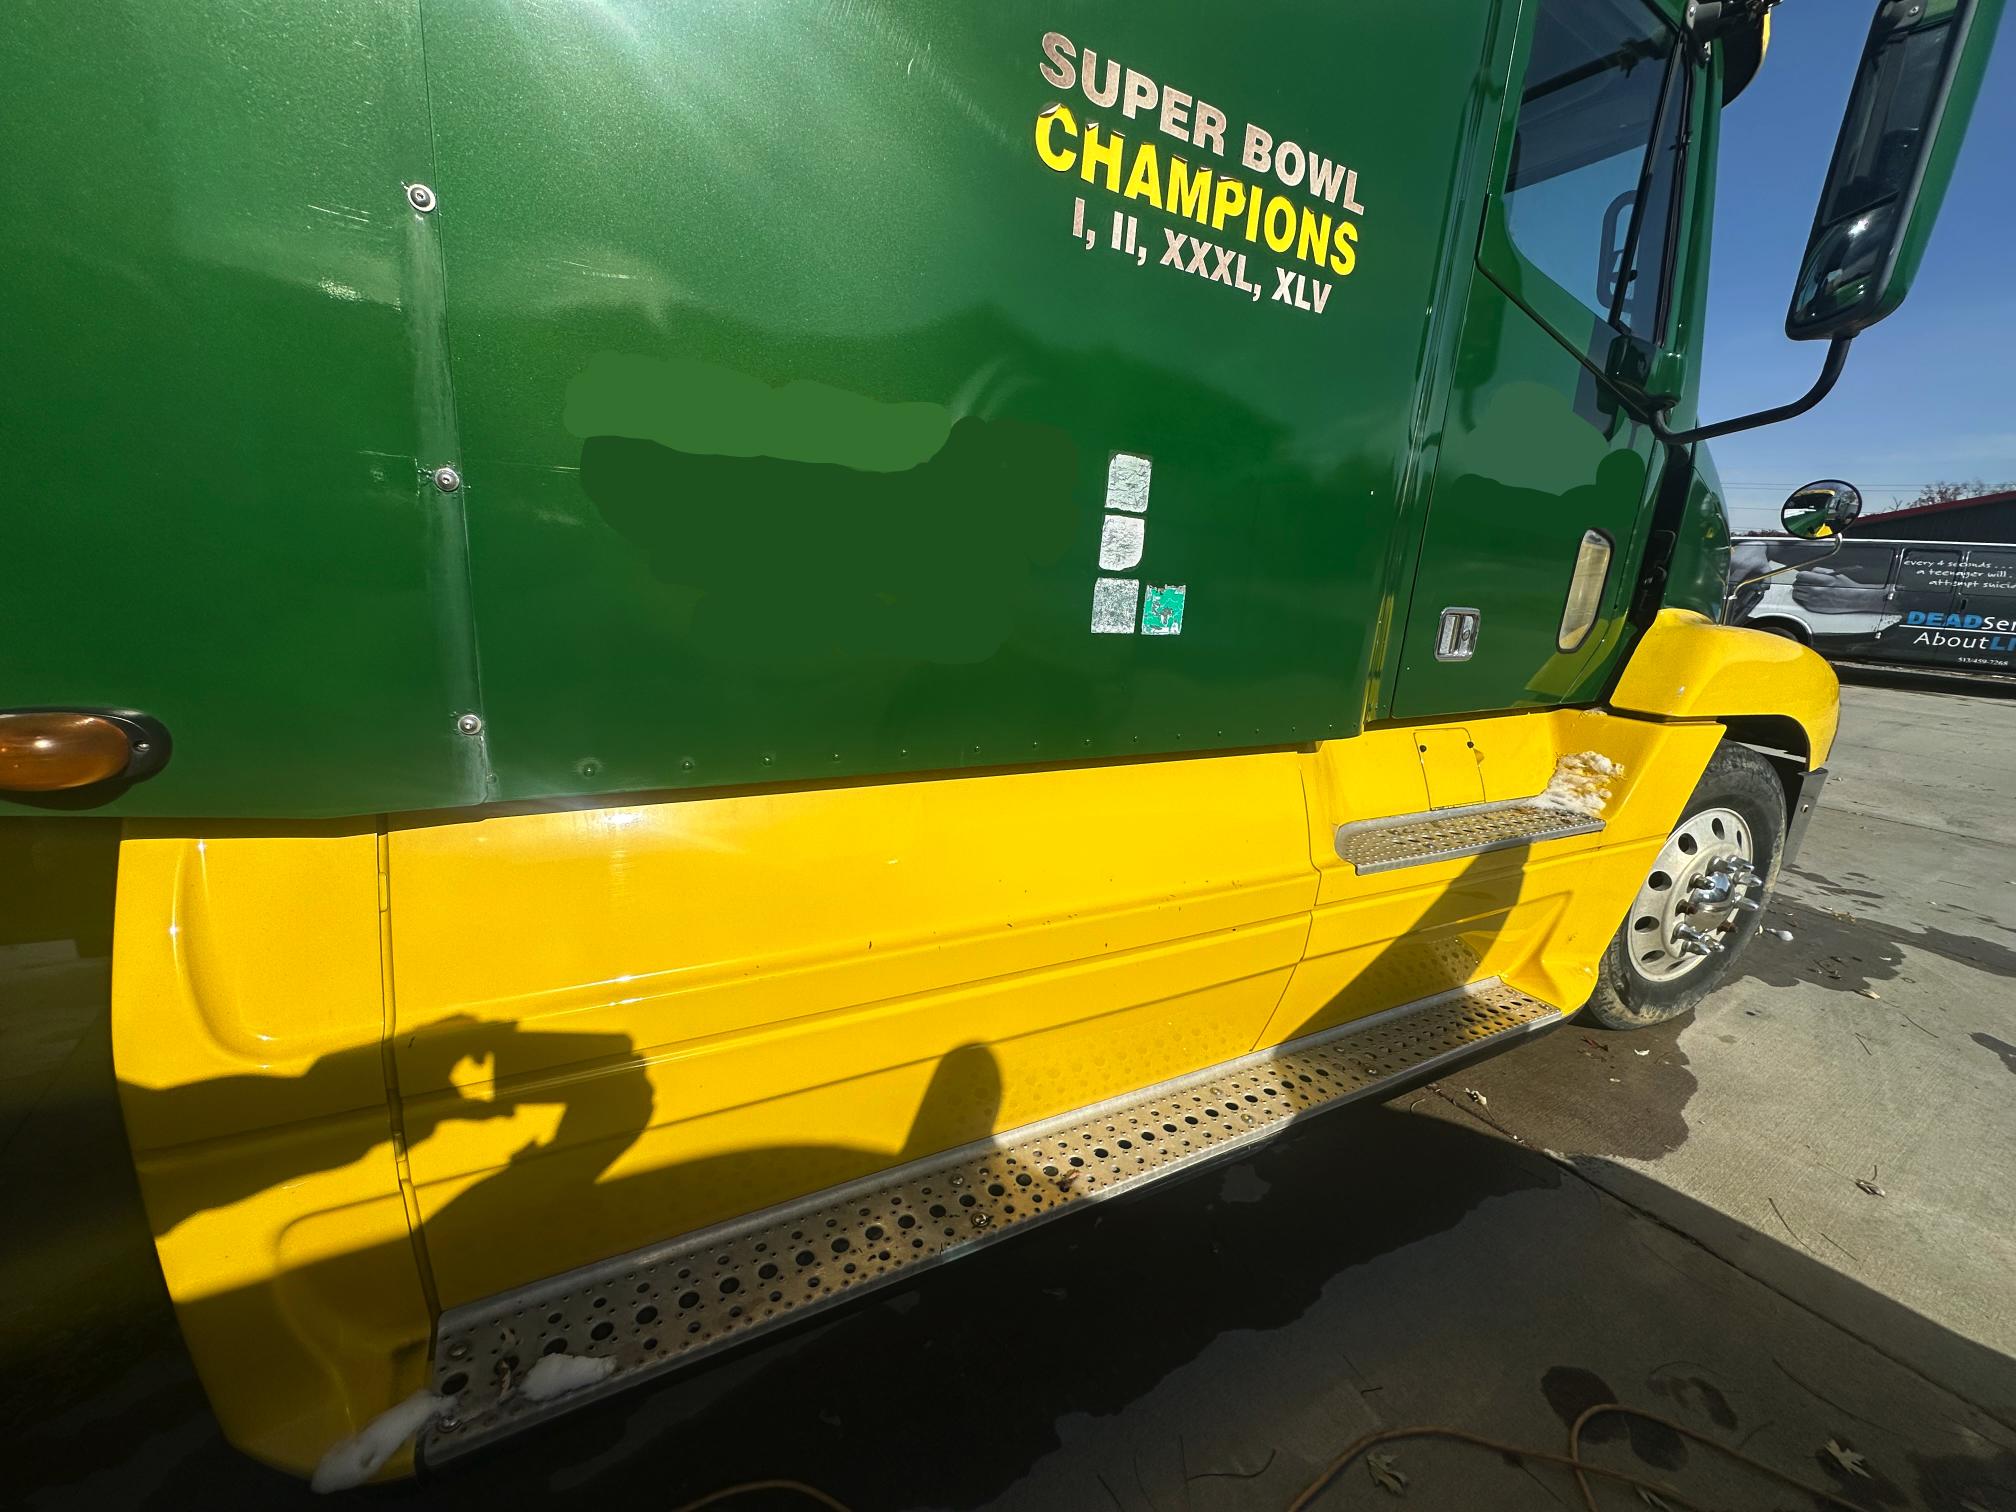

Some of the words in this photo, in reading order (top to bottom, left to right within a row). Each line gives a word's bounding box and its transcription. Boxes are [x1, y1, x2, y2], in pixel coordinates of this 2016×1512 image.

[1039, 31, 1228, 157] SUPER
[1241, 122, 1365, 216] BOWL
[1034, 102, 1359, 277] CHAMPIONS
[1072, 196, 1096, 250] I,
[1111, 210, 1148, 267] II,
[1159, 227, 1262, 302] XXXL,
[1270, 266, 1333, 314] XLV
[1903, 560, 1936, 568] every
[1928, 579, 1980, 588] attempt
[1929, 568, 1985, 579] teenager
